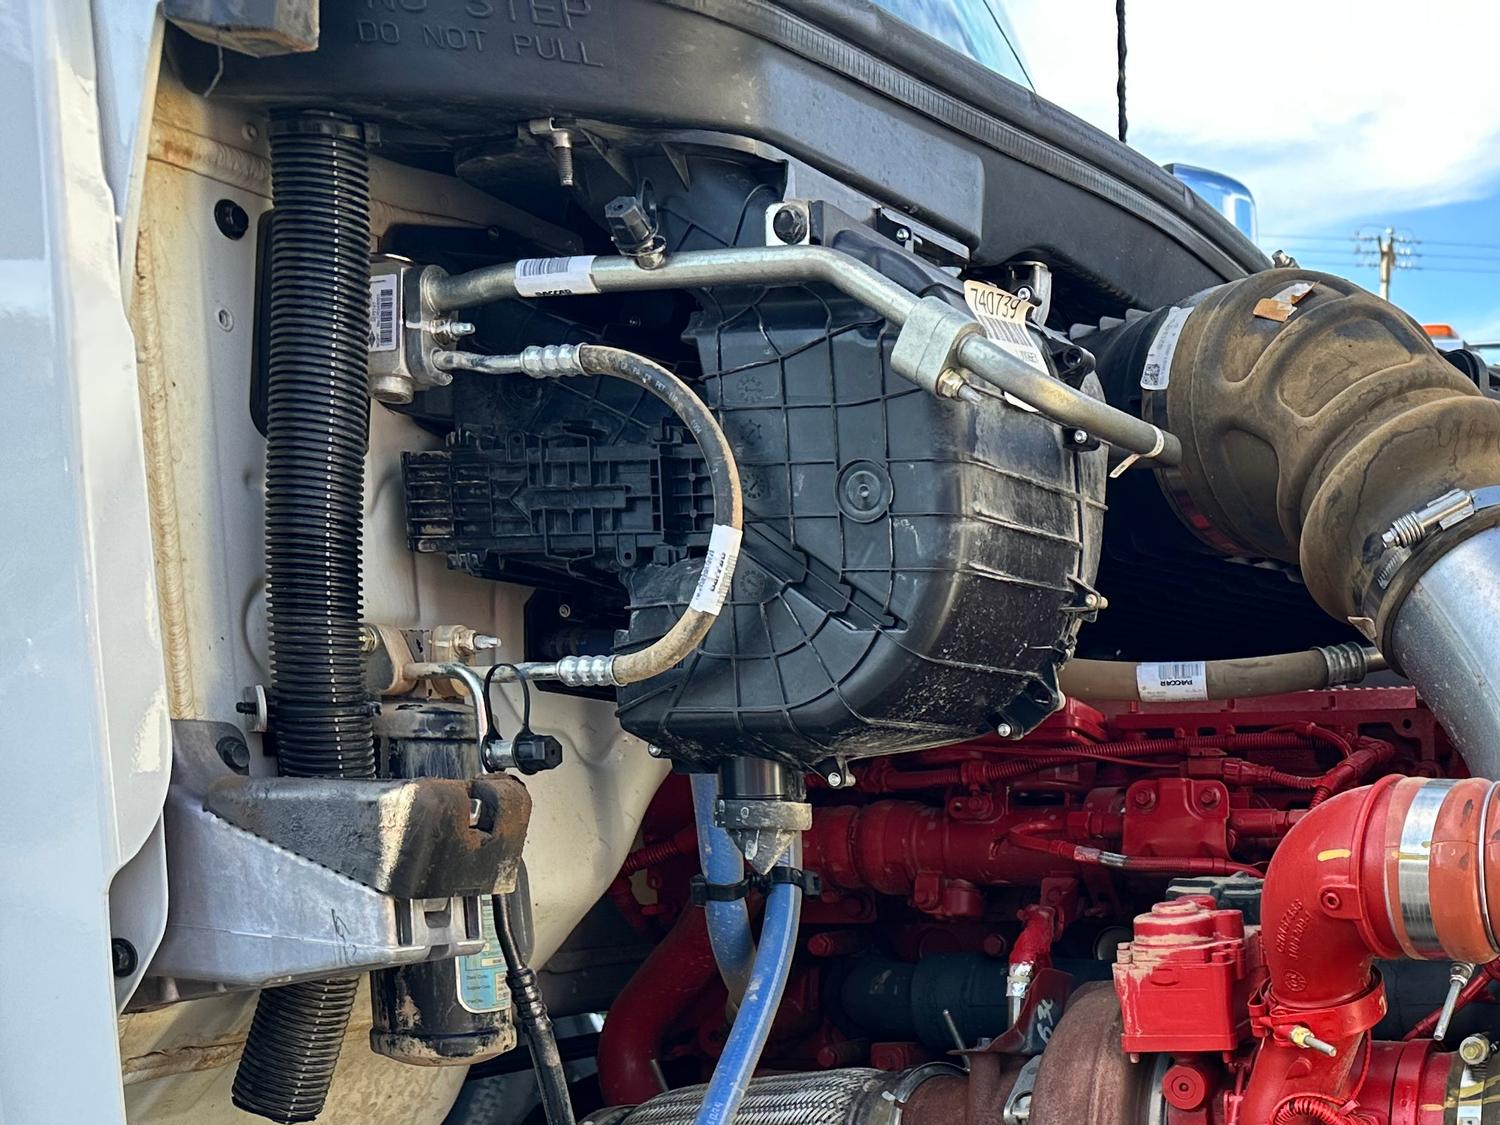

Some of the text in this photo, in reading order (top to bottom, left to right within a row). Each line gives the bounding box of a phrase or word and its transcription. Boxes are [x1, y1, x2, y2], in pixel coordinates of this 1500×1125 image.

[357, 20, 604, 67] DO NOT PULL
[971, 288, 1021, 318] 740739
[1160, 679, 1193, 687] PACCAR
